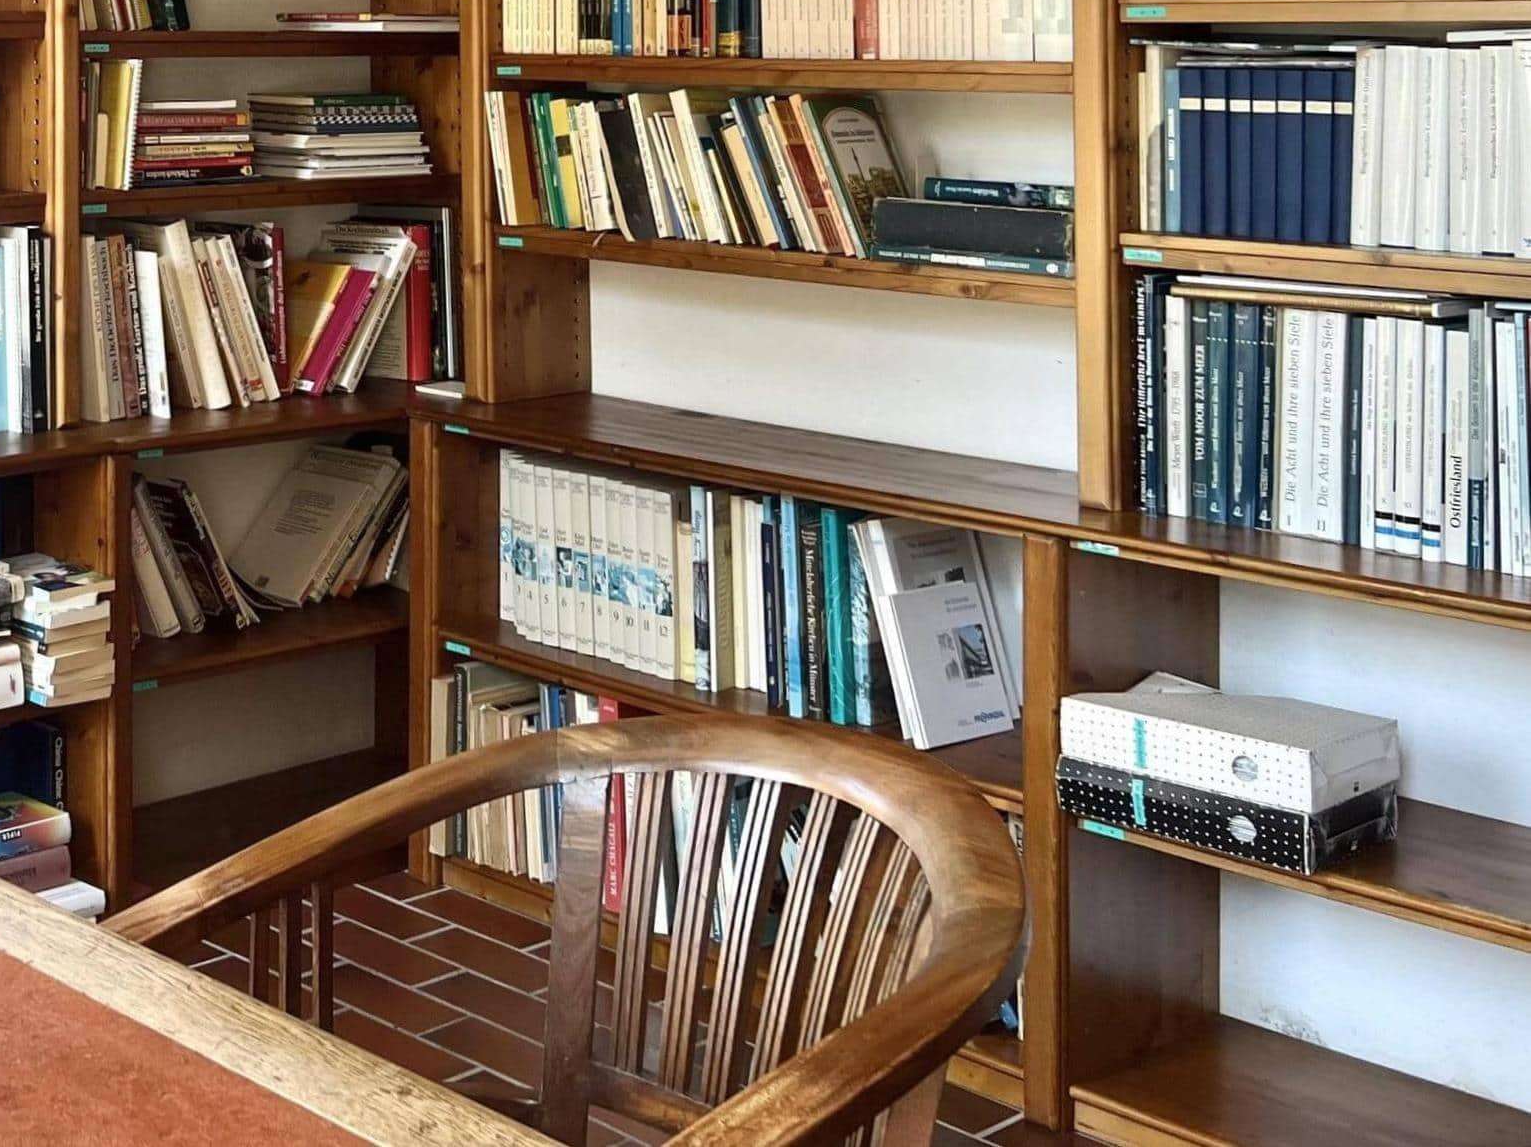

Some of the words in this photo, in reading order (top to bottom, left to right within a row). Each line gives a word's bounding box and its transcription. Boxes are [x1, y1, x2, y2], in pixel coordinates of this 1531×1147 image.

[124, 243, 137, 289] Kochbuch
[128, 291, 139, 308] und
[1287, 316, 1301, 346] Siele
[1320, 318, 1334, 350] Siele
[134, 348, 147, 375] große
[1286, 349, 1300, 389] sieben
[1319, 353, 1333, 393] sieben
[137, 376, 147, 395] Das
[1195, 376, 1205, 400] ZUM
[1286, 392, 1299, 417] ihre
[1318, 397, 1332, 420] ihre
[1195, 401, 1205, 435] MOOR
[1285, 421, 1298, 444] und
[1317, 424, 1331, 448] und
[1195, 437, 1205, 460] VOM
[1285, 448, 1298, 478] Acht
[1316, 451, 1330, 481] Acht
[1284, 481, 1296, 502] Die
[1315, 485, 1329, 507] Die
[1449, 454, 1464, 529] Ostfriesland
[544, 594, 549, 604] 5
[580, 601, 585, 611] 7
[613, 611, 619, 621] 9
[626, 616, 633, 627] 10
[659, 625, 668, 636] 12
[2, 830, 21, 840] PIPER
